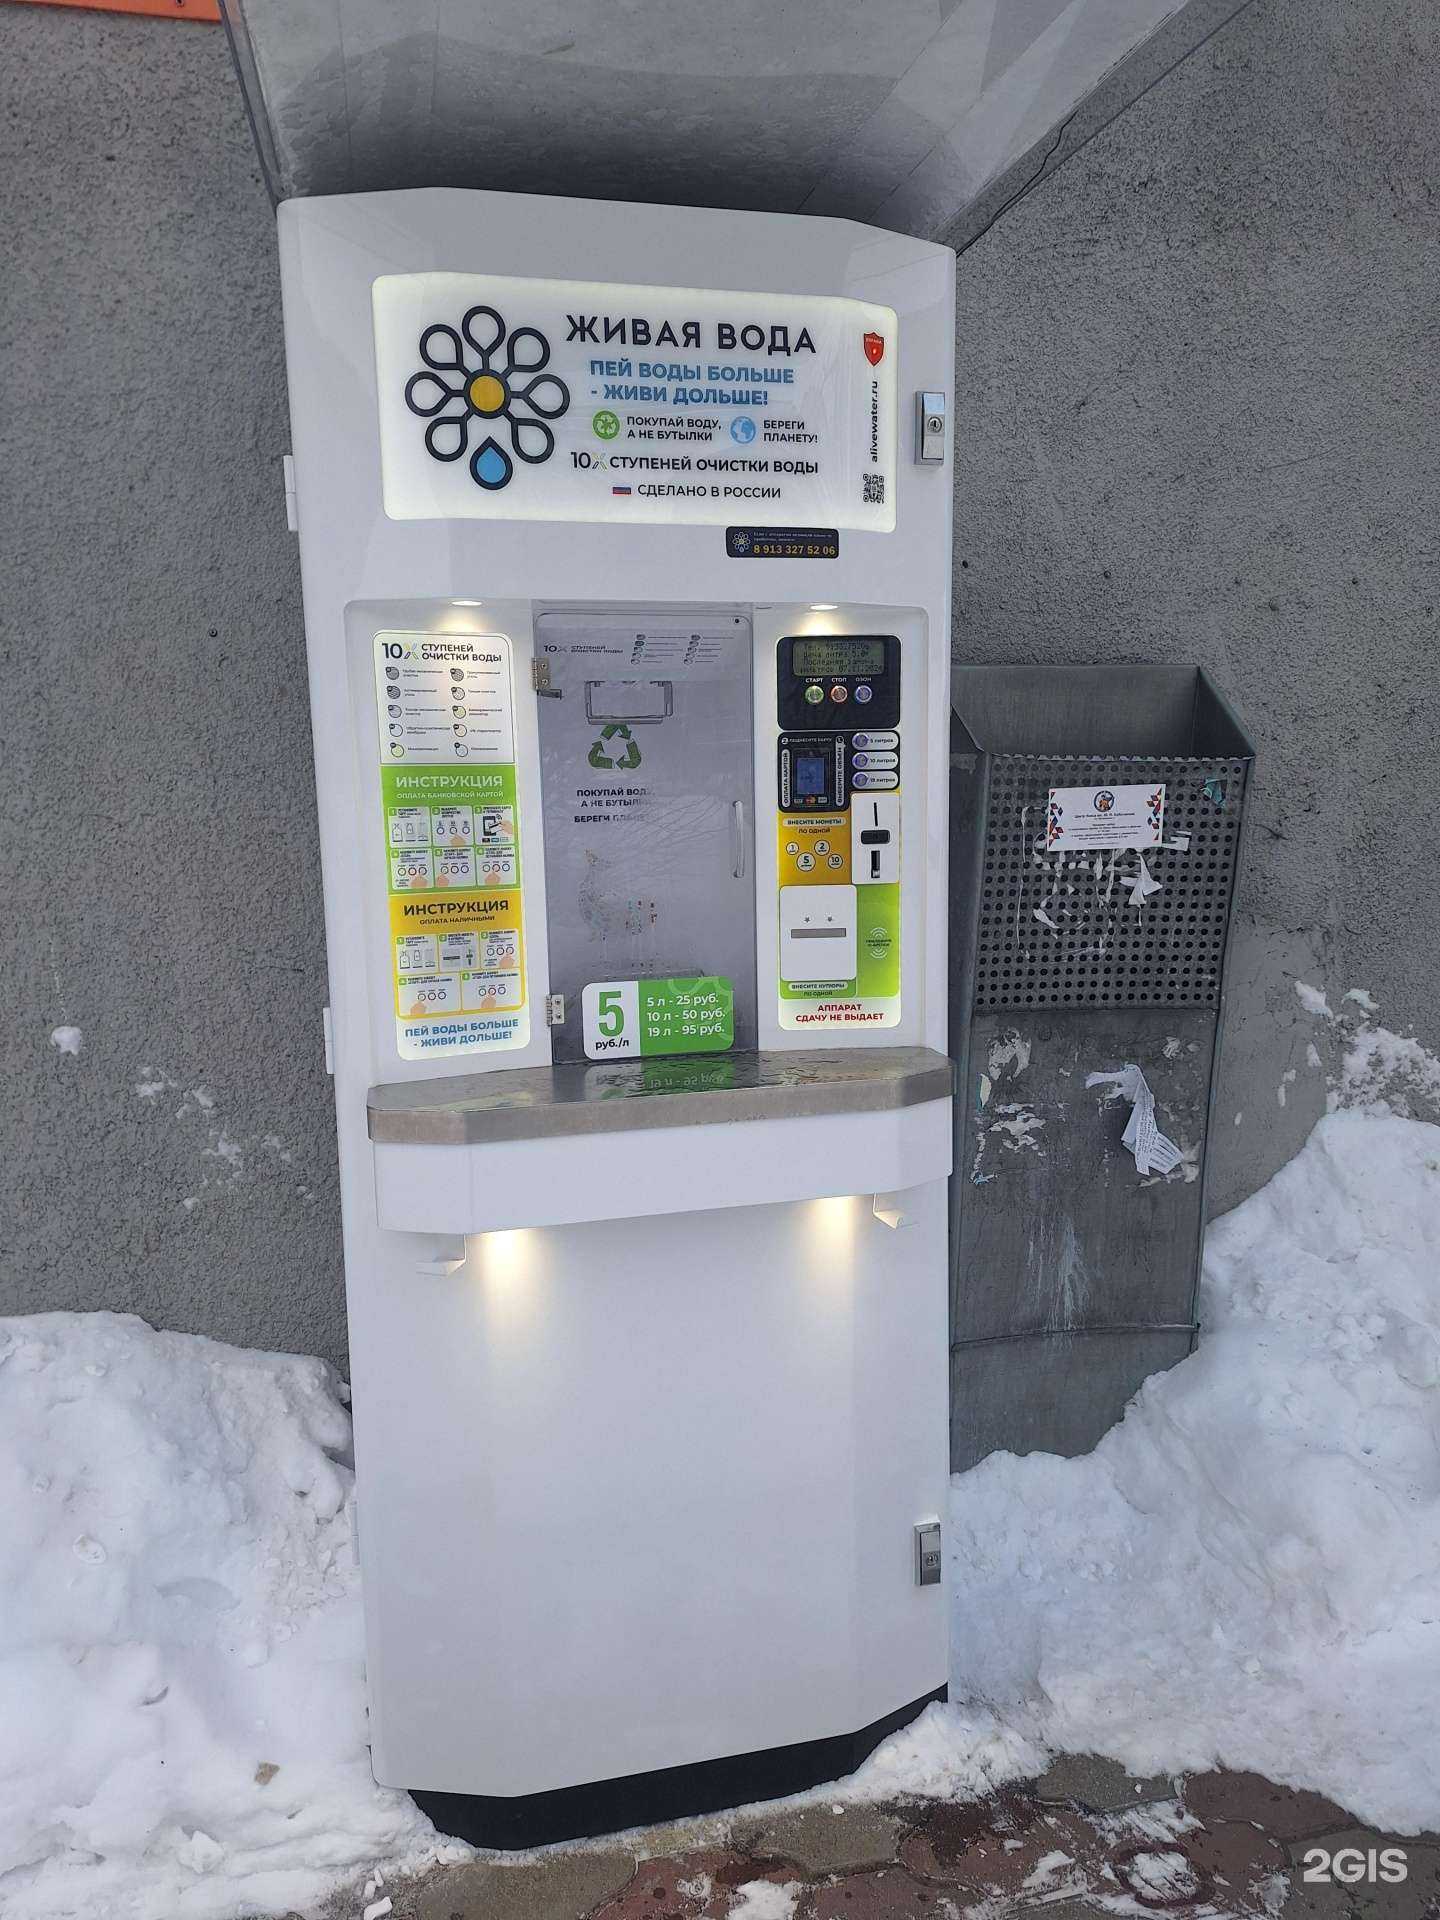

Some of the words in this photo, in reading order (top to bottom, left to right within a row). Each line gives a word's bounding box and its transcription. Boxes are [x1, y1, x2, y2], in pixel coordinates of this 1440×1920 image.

[566, 315, 701, 348] ЖИВАЯ
[718, 323, 816, 356] ВОДА
[590, 357, 632, 377] ПЕЙ
[639, 363, 700, 382] ВОДЫ
[708, 365, 794, 383] БОЛЬШЕ
[604, 384, 667, 402] ЖИВИ
[673, 387, 768, 405] ДОЛЬШЕ!
[627, 416, 683, 427] ПОКУПАЙ
[688, 418, 721, 430] ВОДУ,
[764, 420, 805, 430] БЕРЕГИ
[870, 381, 878, 463] alivewater.ru
[627, 430, 635, 438] А
[639, 430, 654, 439] НЕ
[657, 431, 713, 441] БУТЫЛКИ
[764, 432, 818, 443] ПЛАНЕТУ!
[610, 456, 691, 470] СТУПЕНЕЙ
[697, 459, 769, 472] ОЧИСТКИ
[773, 461, 818, 475] ВОДЫ
[637, 484, 707, 497] СДЕЛАНО
[711, 487, 719, 497] В
[724, 487, 781, 498] РОССИИ
[753, 545, 760, 554] 8
[763, 545, 782, 554] 913
[786, 545, 803, 554] 327
[807, 546, 820, 555] 52
[823, 546, 836, 555] 06
[421, 643, 474, 652] СТУПЕНЕЙ
[422, 652, 469, 661] ОЧИСТКИ
[472, 654, 502, 663] ВОДЫ
[396, 775, 503, 789] ИНСТРУКЦИЯ
[476, 790, 504, 798] КАРТОЙ
[577, 787, 624, 796] ПОКУПАЙ
[574, 815, 610, 823] БЕРЕГИ
[404, 900, 509, 916] ИНСТРУКЦИЯ
[450, 915, 495, 924] НАЛИЧНЫМИ
[647, 998, 654, 1007] 5
[657, 998, 665, 1006] л
[676, 995, 690, 1005] 25
[693, 993, 719, 1005] руб.
[598, 990, 625, 1037] 5
[648, 1012, 660, 1021] 10
[664, 1013, 671, 1021] л
[682, 1010, 697, 1019] 50
[701, 1008, 725, 1020] руб.
[818, 1004, 862, 1012] АППАРАТ
[844, 1013, 884, 1021] ВЫДАЕТ
[405, 1026, 429, 1037] ПЕЙ
[432, 1023, 468, 1034] ВОДЫ
[470, 1019, 519, 1031] БОЛЬШЕ
[648, 1027, 660, 1036] 19
[682, 1025, 696, 1034] 95
[700, 1023, 725, 1036] руб.
[421, 1036, 456, 1047] ЖИВИ
[459, 1031, 512, 1044] ДОЛЬШЕ!
[595, 1038, 629, 1050] руб./л
